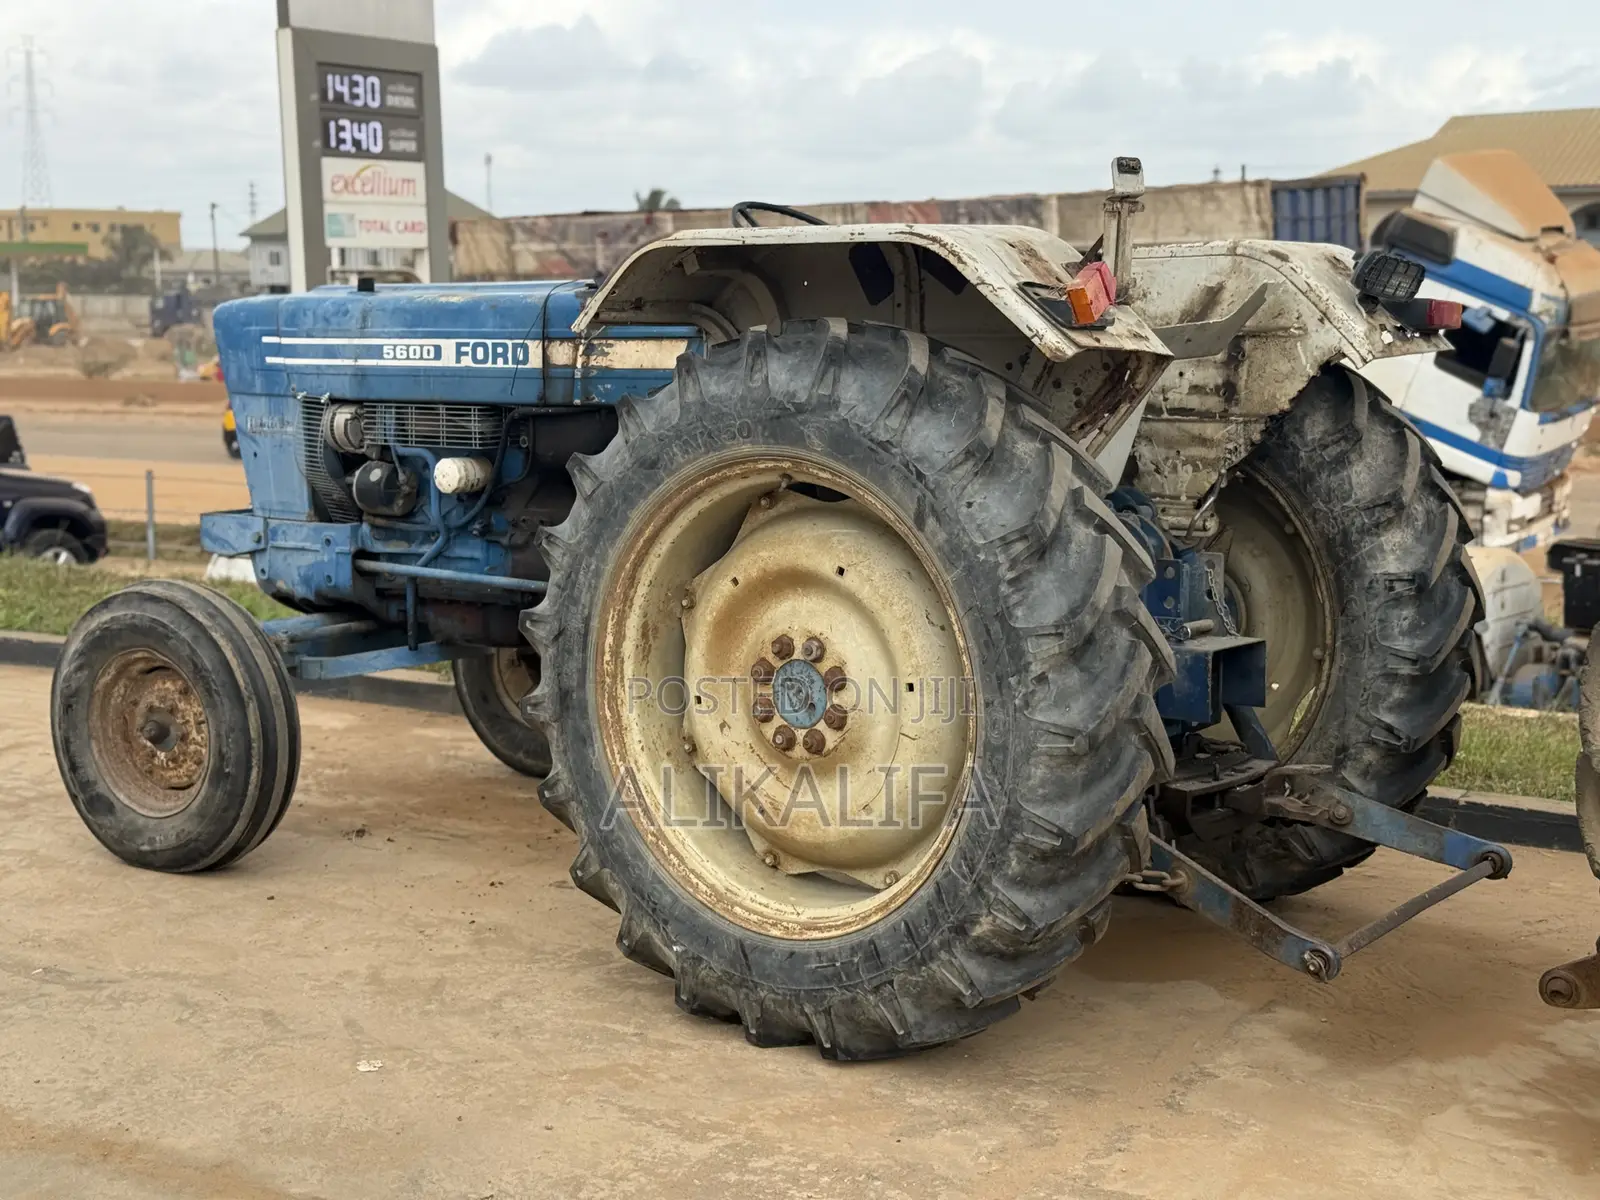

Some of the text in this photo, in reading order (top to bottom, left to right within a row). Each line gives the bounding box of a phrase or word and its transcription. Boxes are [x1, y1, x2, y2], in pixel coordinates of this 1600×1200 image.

[331, 169, 417, 197] excellium
[358, 219, 426, 234] TOTAL CARD
[382, 341, 530, 366] 5600 FORD
